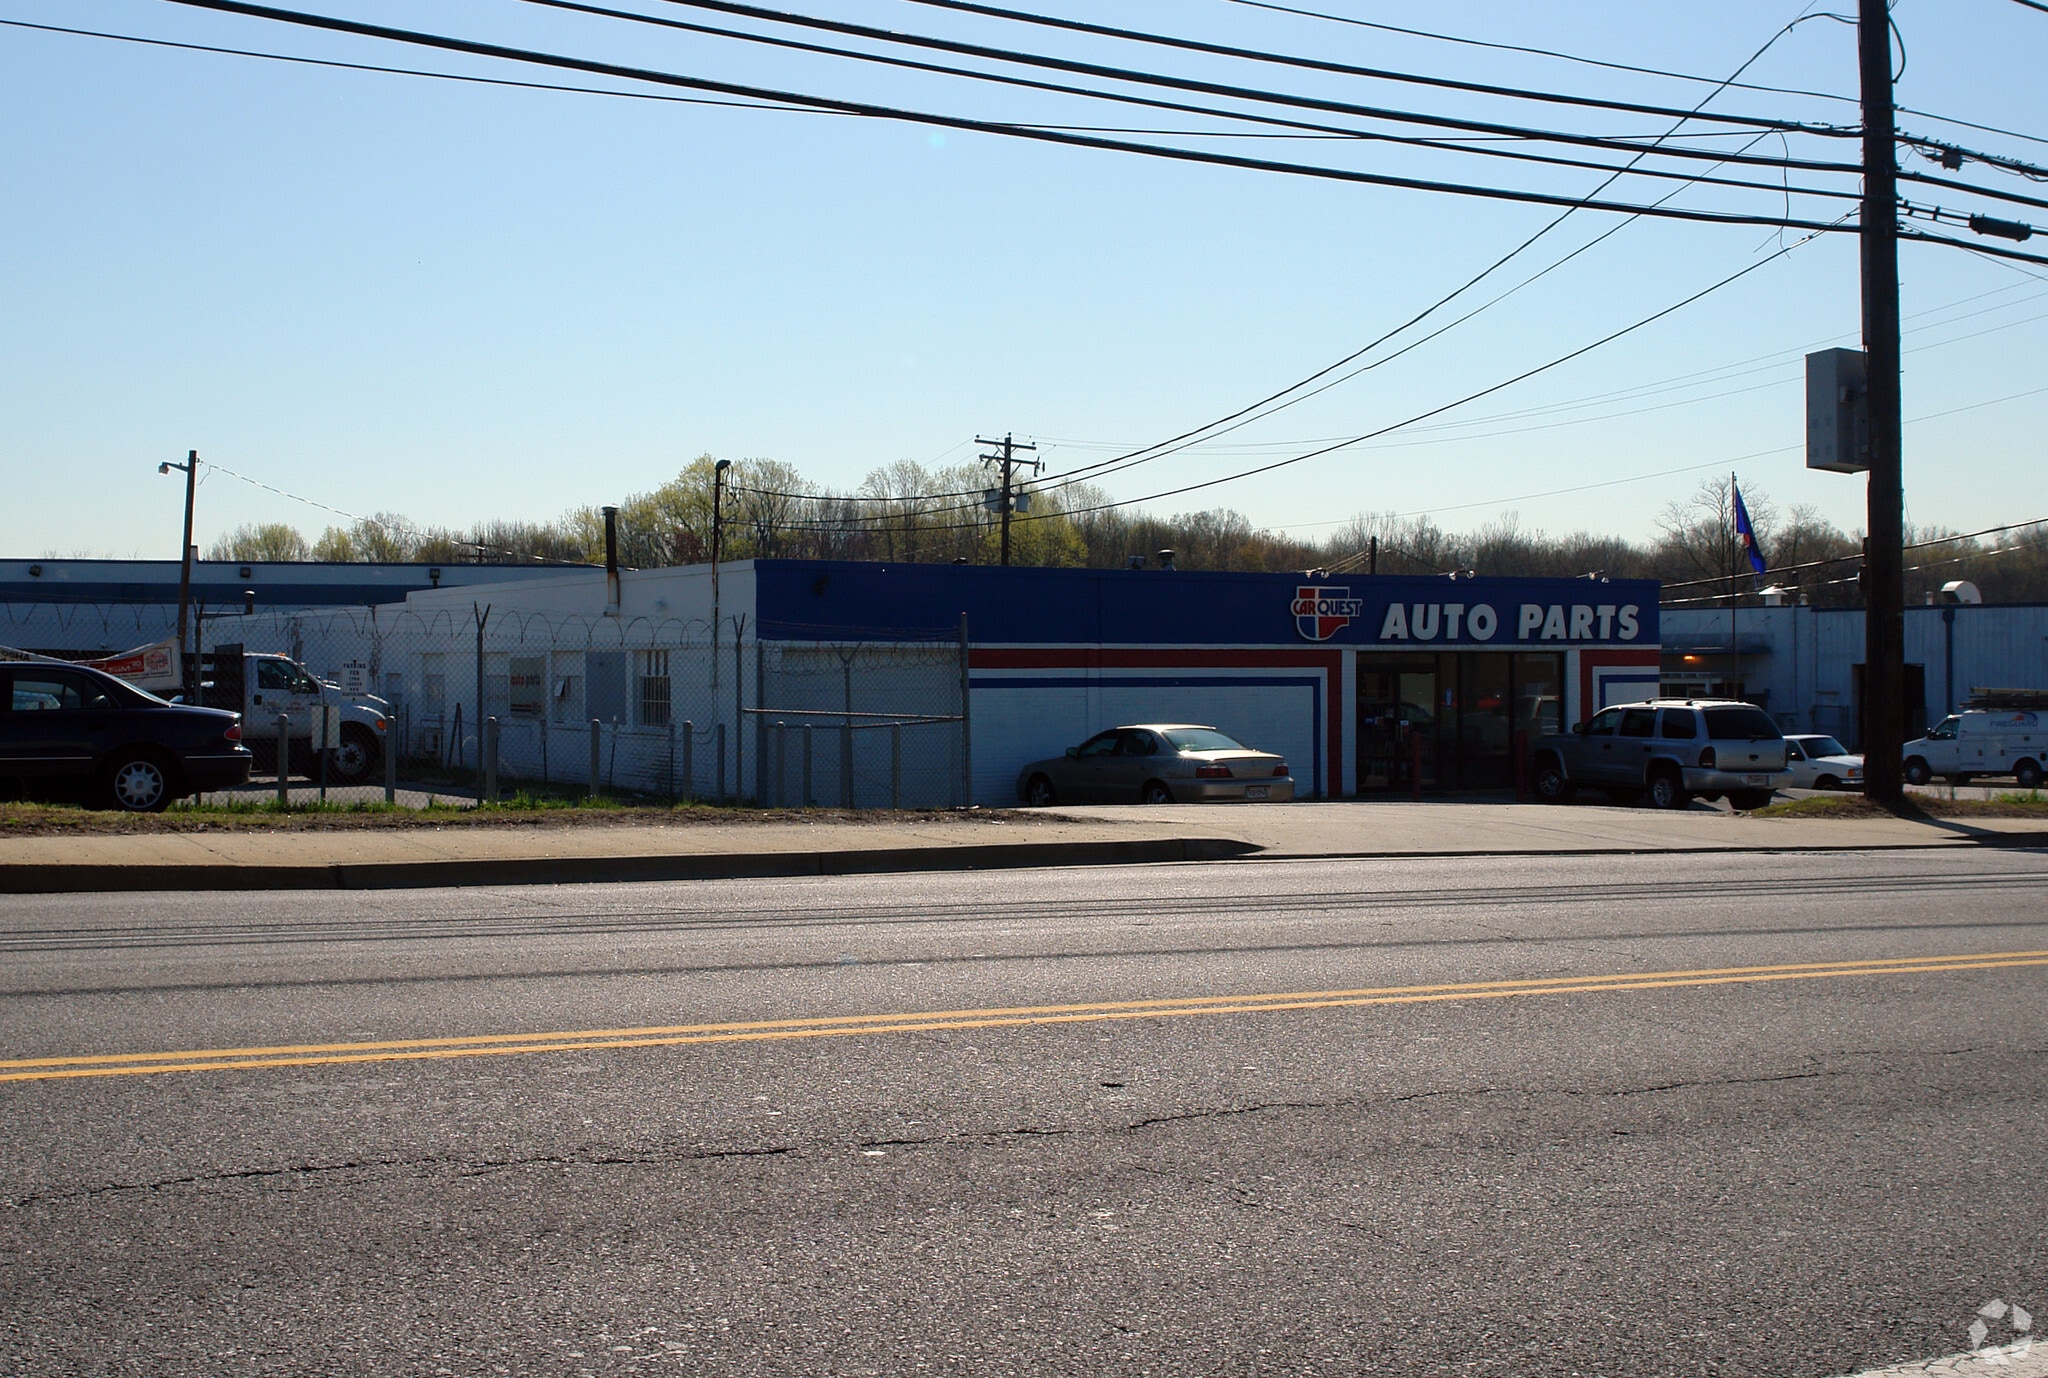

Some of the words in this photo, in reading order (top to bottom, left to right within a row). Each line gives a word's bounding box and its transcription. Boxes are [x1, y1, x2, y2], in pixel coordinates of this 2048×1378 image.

[1292, 599, 1362, 617] CARQUEST
[1379, 603, 1498, 641] AUTO
[1518, 604, 1640, 641] PARTS
